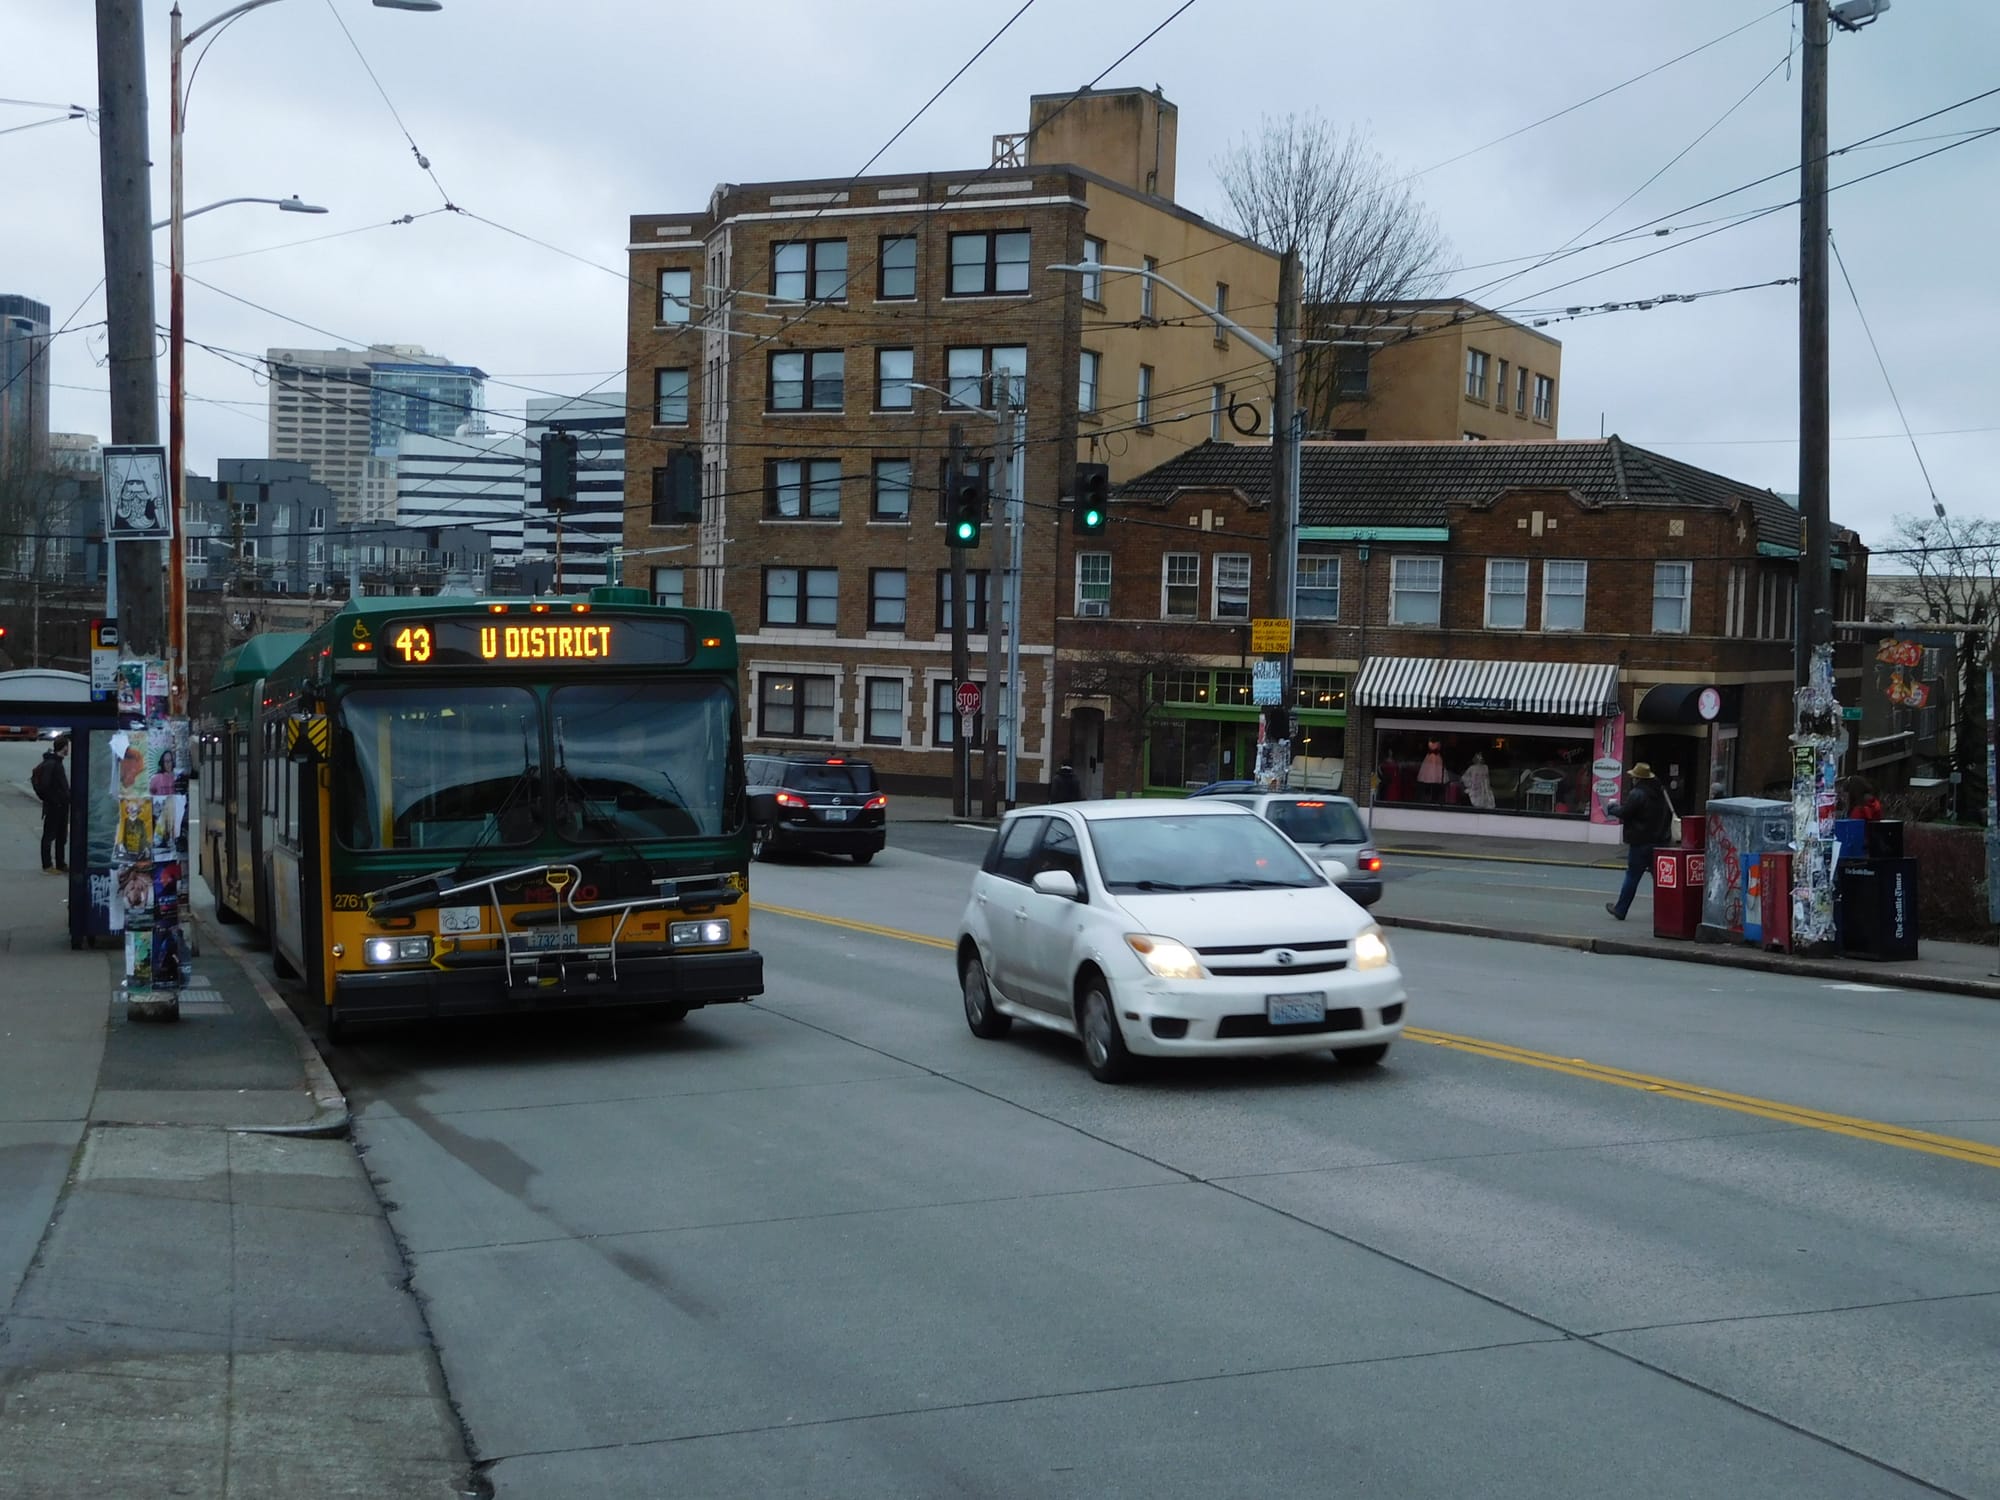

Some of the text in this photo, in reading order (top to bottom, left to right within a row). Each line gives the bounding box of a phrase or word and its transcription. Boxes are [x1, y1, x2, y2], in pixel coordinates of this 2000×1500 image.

[396, 628, 431, 661] 43
[481, 627, 610, 658] U DISTRICT
[958, 693, 979, 706] STOP
[1660, 861, 1673, 874] City
[1894, 872, 1904, 939] The Seattle Times
